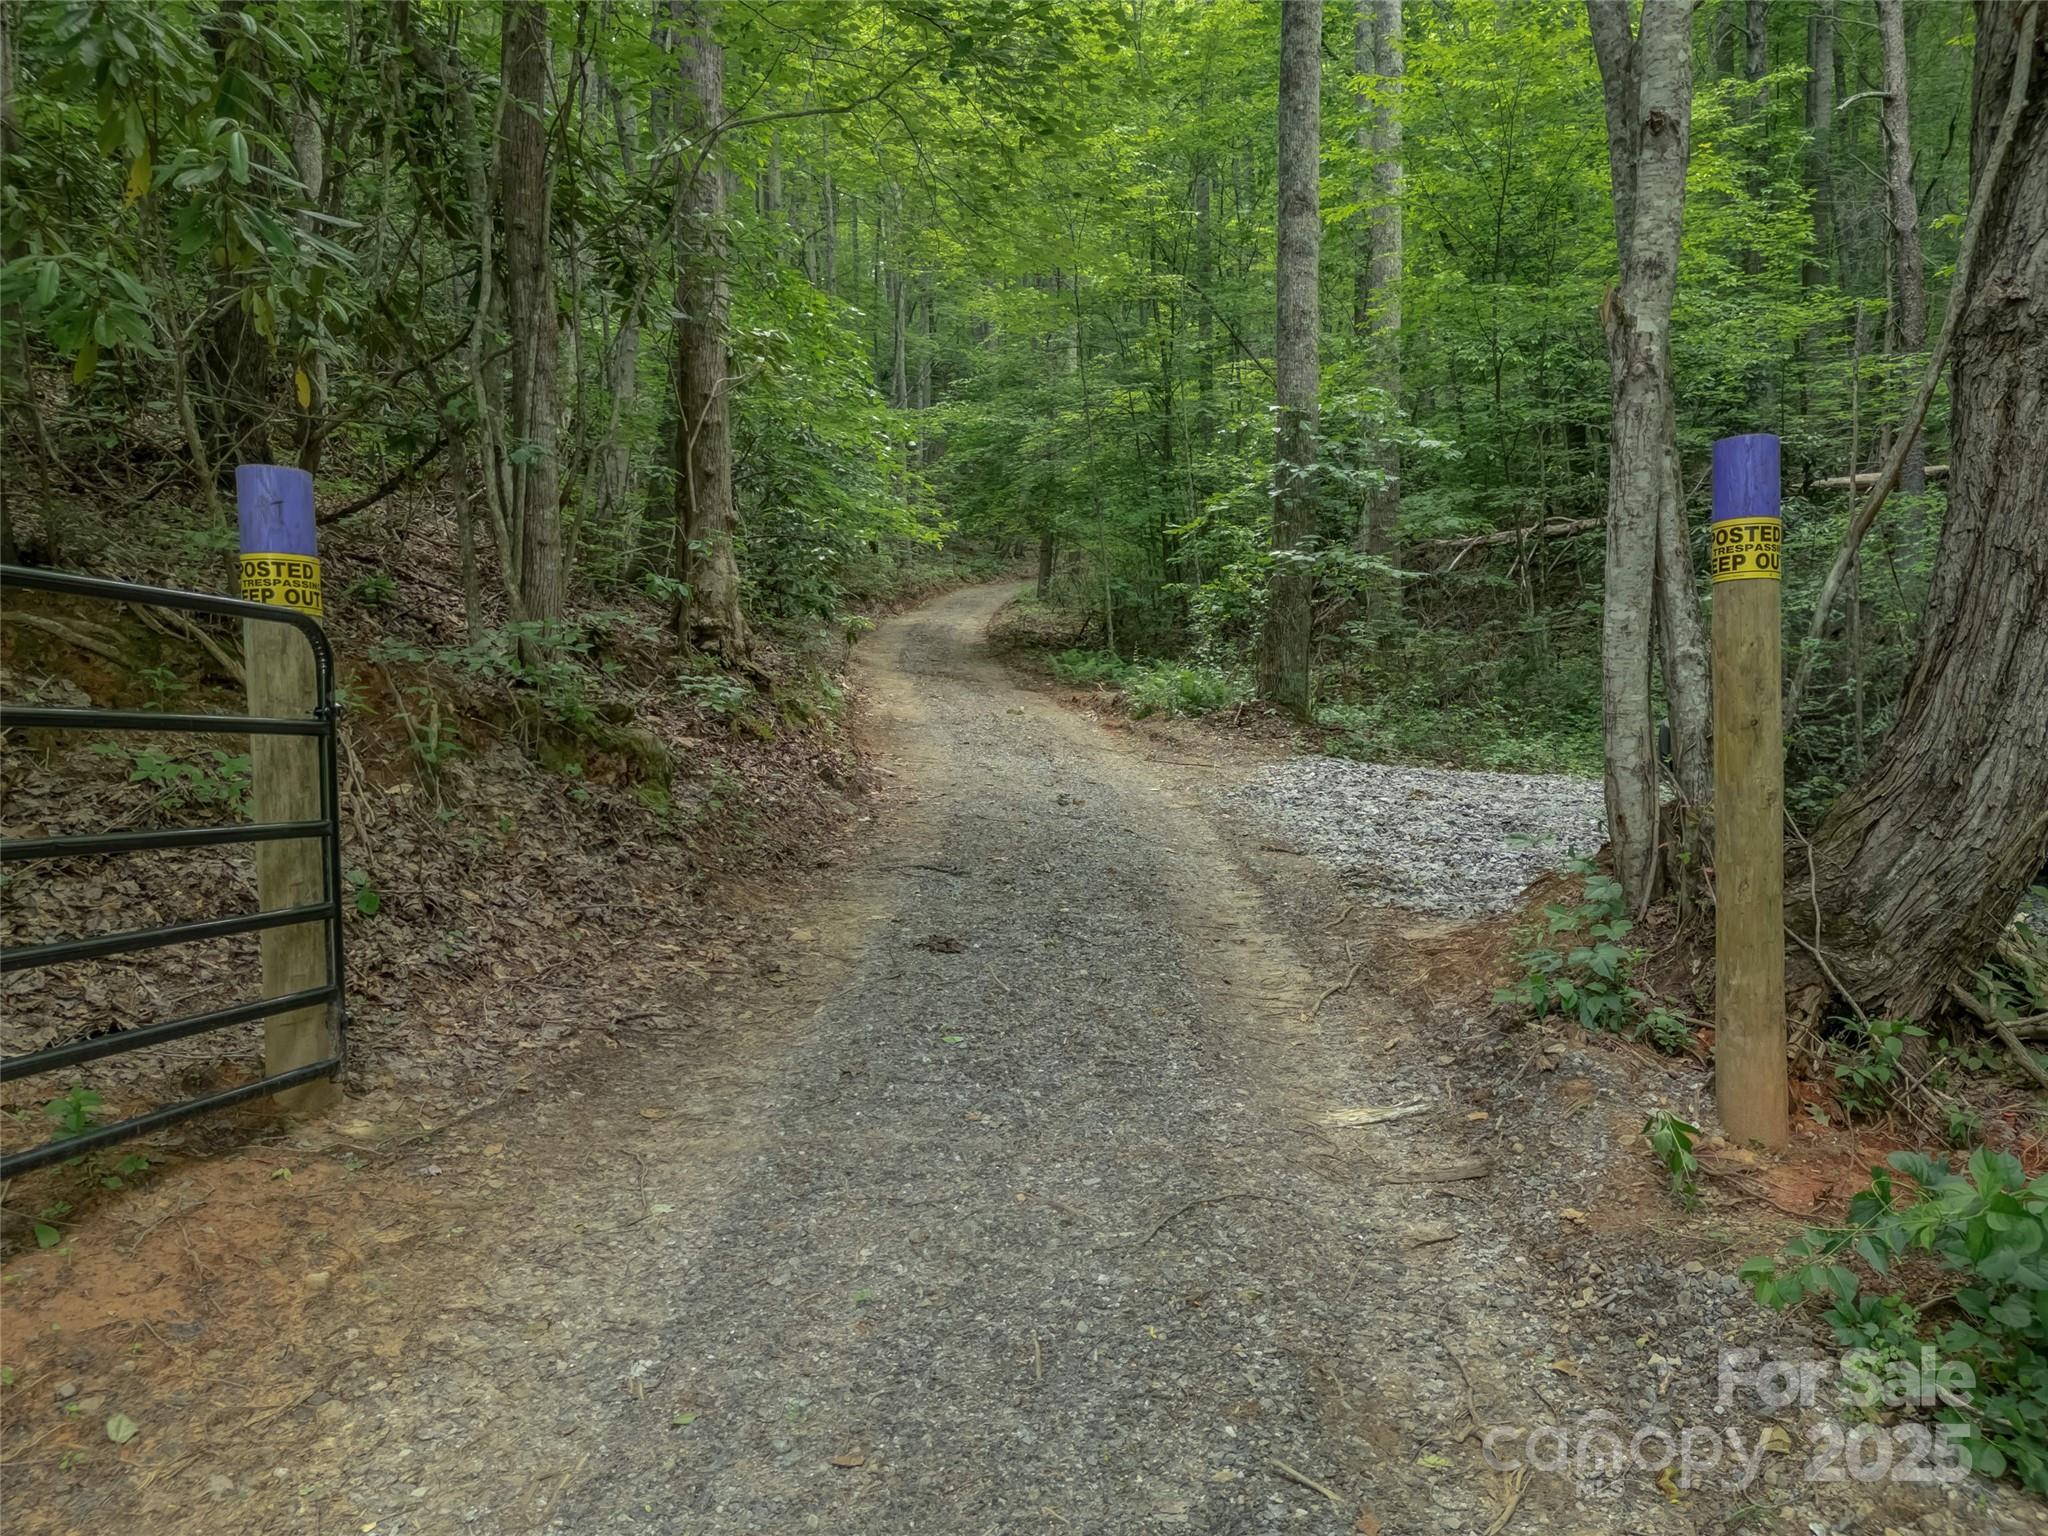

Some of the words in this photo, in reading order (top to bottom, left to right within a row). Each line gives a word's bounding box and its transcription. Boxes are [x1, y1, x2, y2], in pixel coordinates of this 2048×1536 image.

[1712, 554, 1746, 574] EEP
[1756, 553, 1779, 570] OU
[242, 588, 275, 604] EEP
[284, 588, 320, 607] OUT
